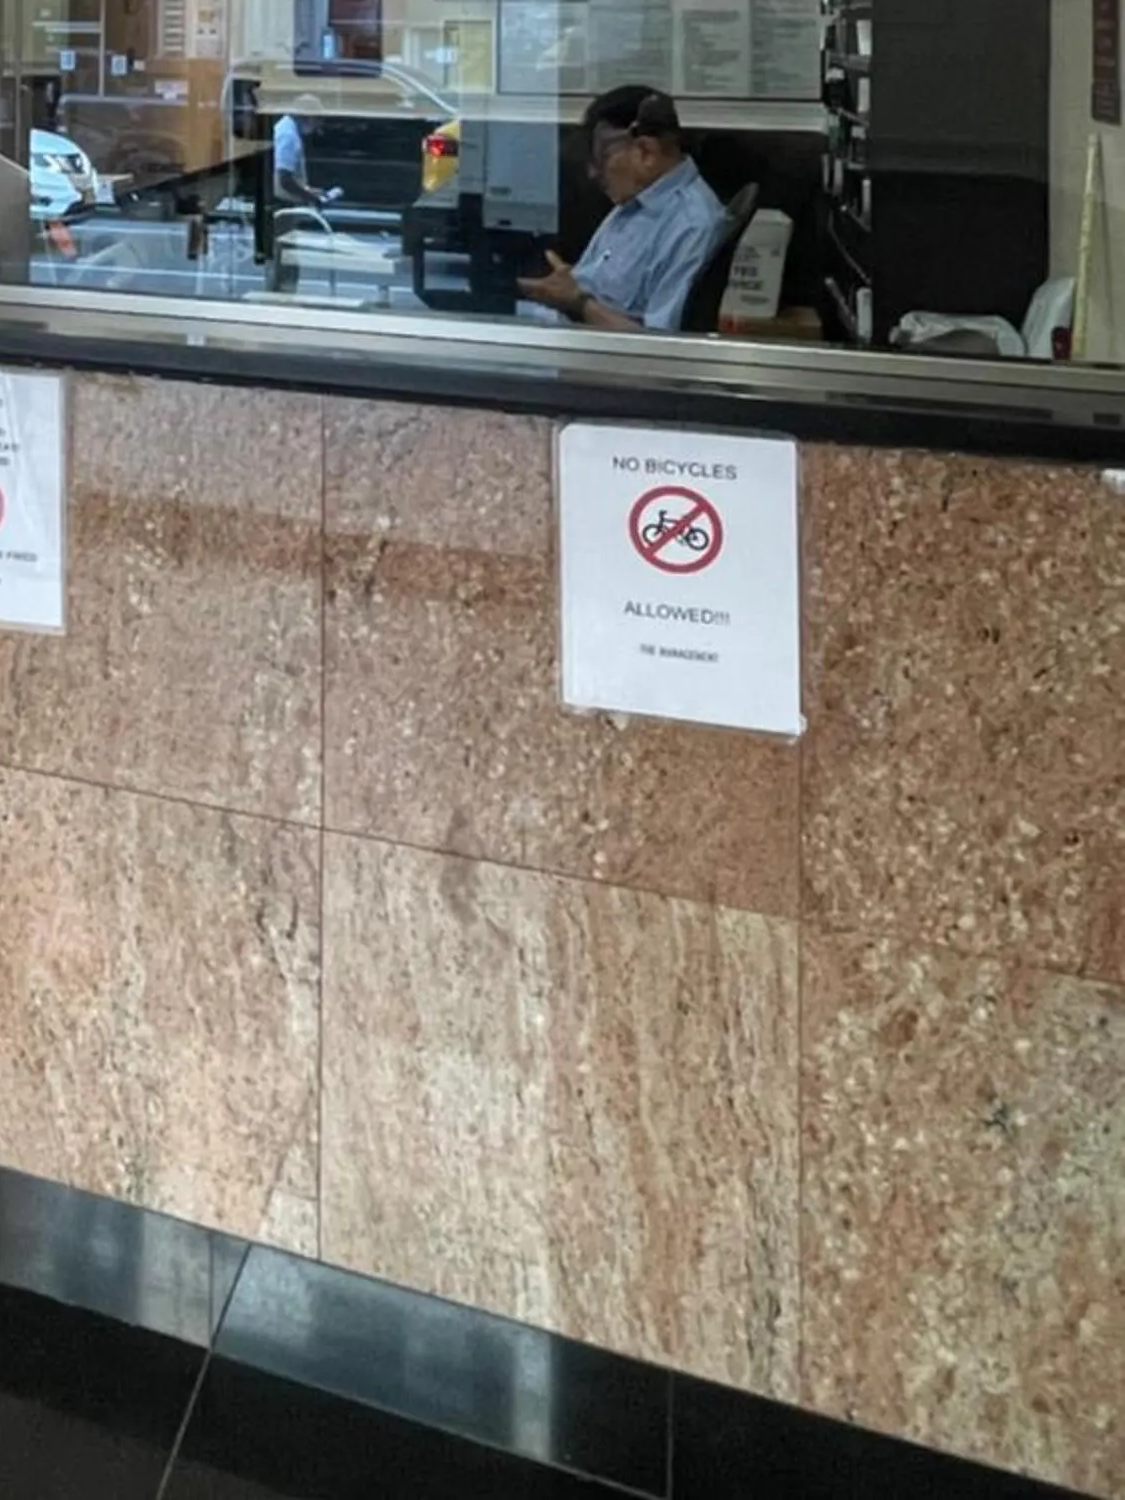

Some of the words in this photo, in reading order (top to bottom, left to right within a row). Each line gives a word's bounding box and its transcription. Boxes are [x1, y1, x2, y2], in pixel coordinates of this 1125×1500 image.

[612, 455, 640, 472] NO
[645, 457, 738, 481] BICYCLES
[623, 600, 731, 626] ALLOWED!!!
